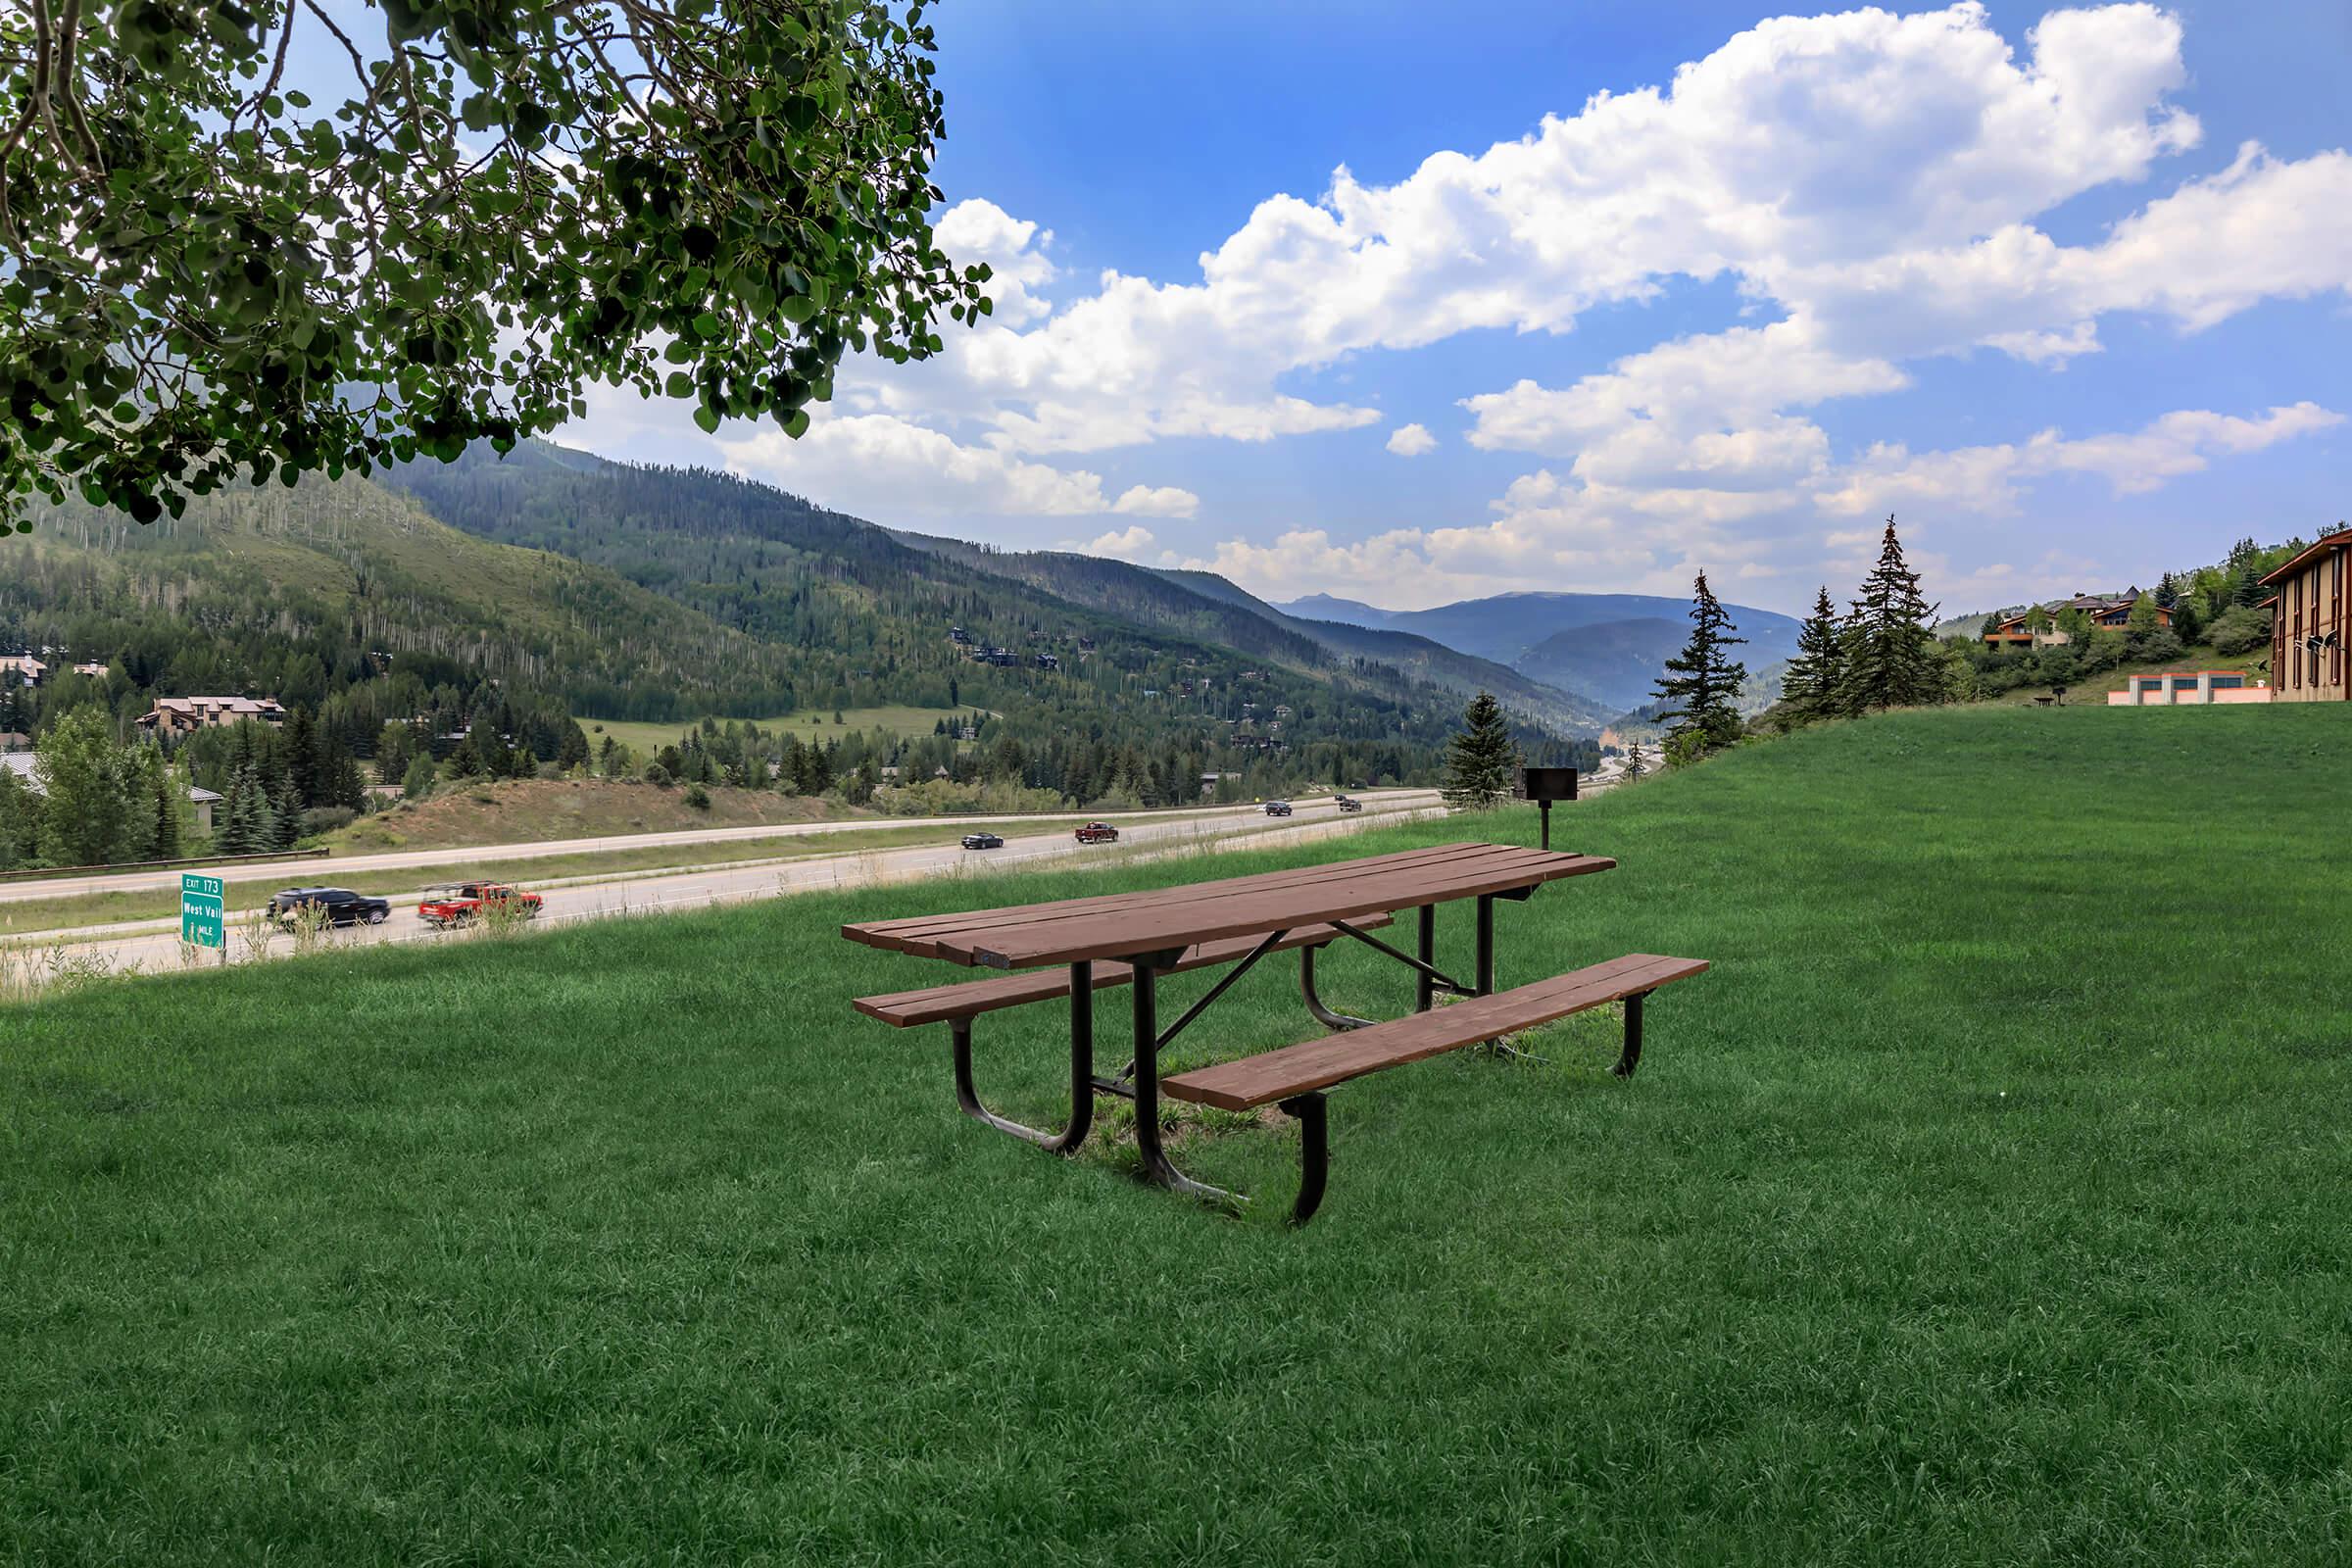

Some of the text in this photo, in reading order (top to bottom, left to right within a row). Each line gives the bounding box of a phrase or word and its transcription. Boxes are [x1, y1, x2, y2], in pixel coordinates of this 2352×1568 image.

[186, 879, 219, 893] EXIT 173
[184, 903, 220, 919] West Vail
